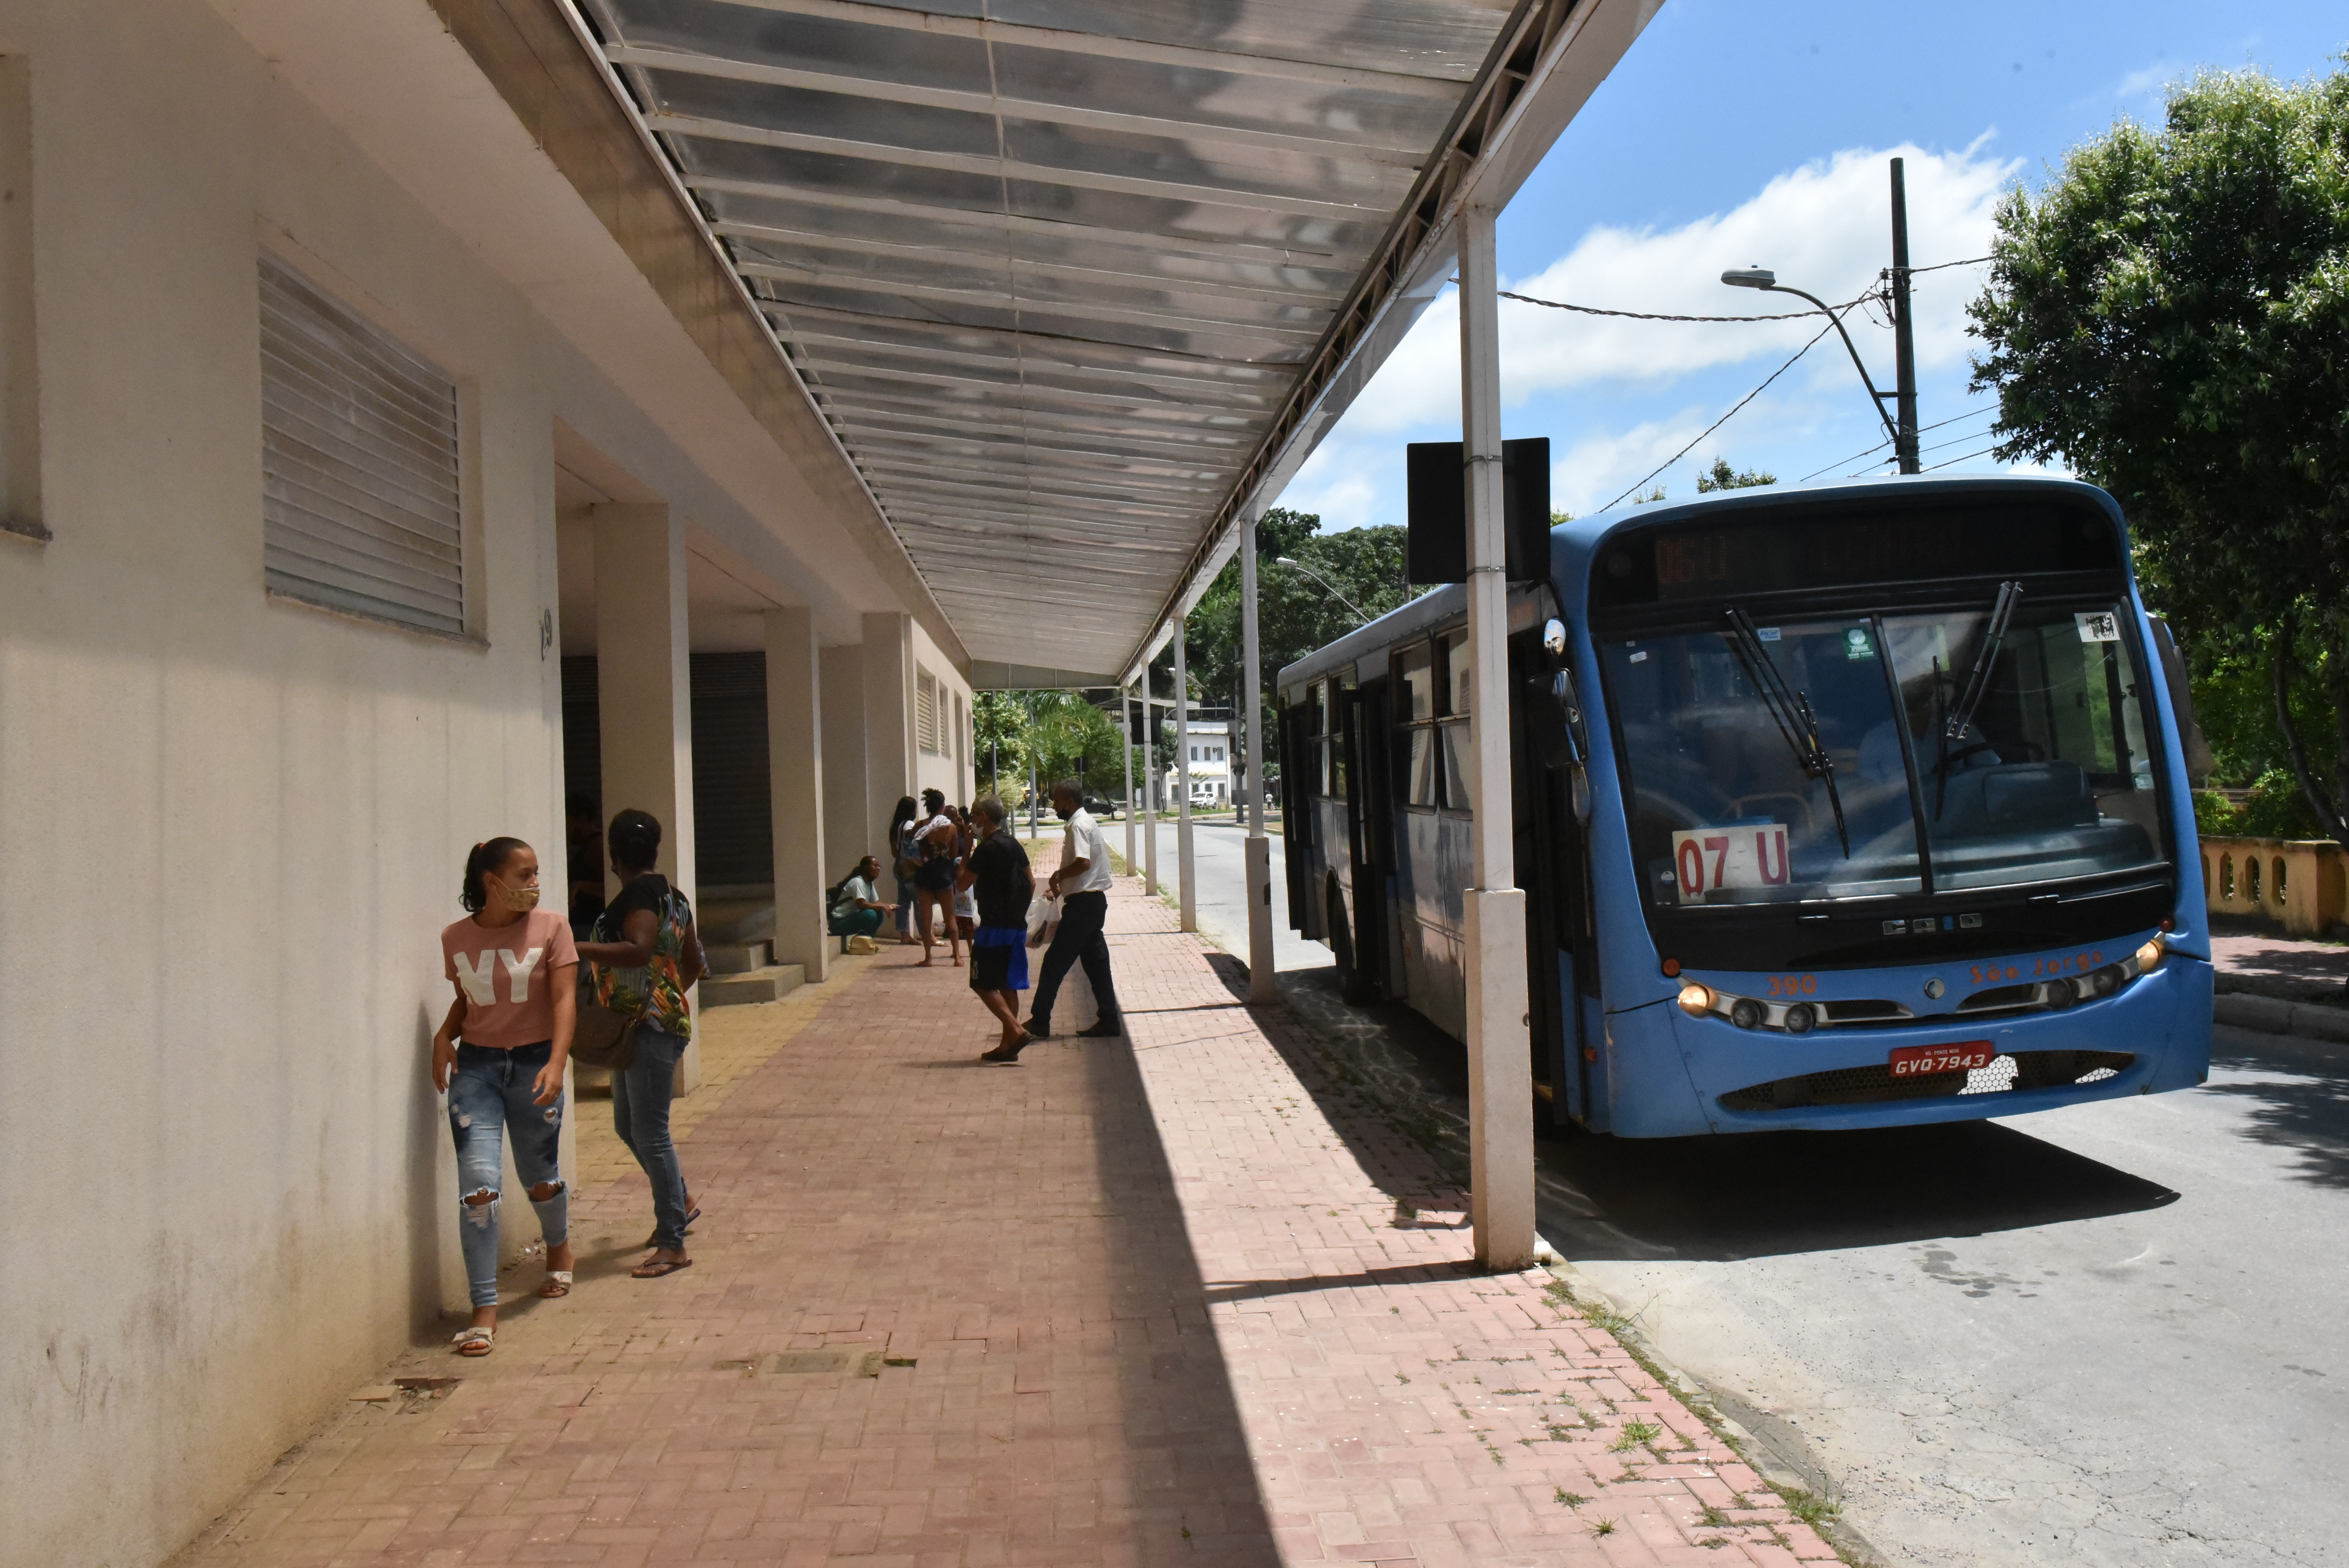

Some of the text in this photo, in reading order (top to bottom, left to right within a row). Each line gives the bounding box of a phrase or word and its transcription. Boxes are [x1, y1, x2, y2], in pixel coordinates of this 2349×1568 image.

[1678, 830, 1788, 897] 07 U
[453, 947, 543, 1007] NY
[1767, 974, 1816, 996] 390
[1971, 950, 2103, 984] São Jorge
